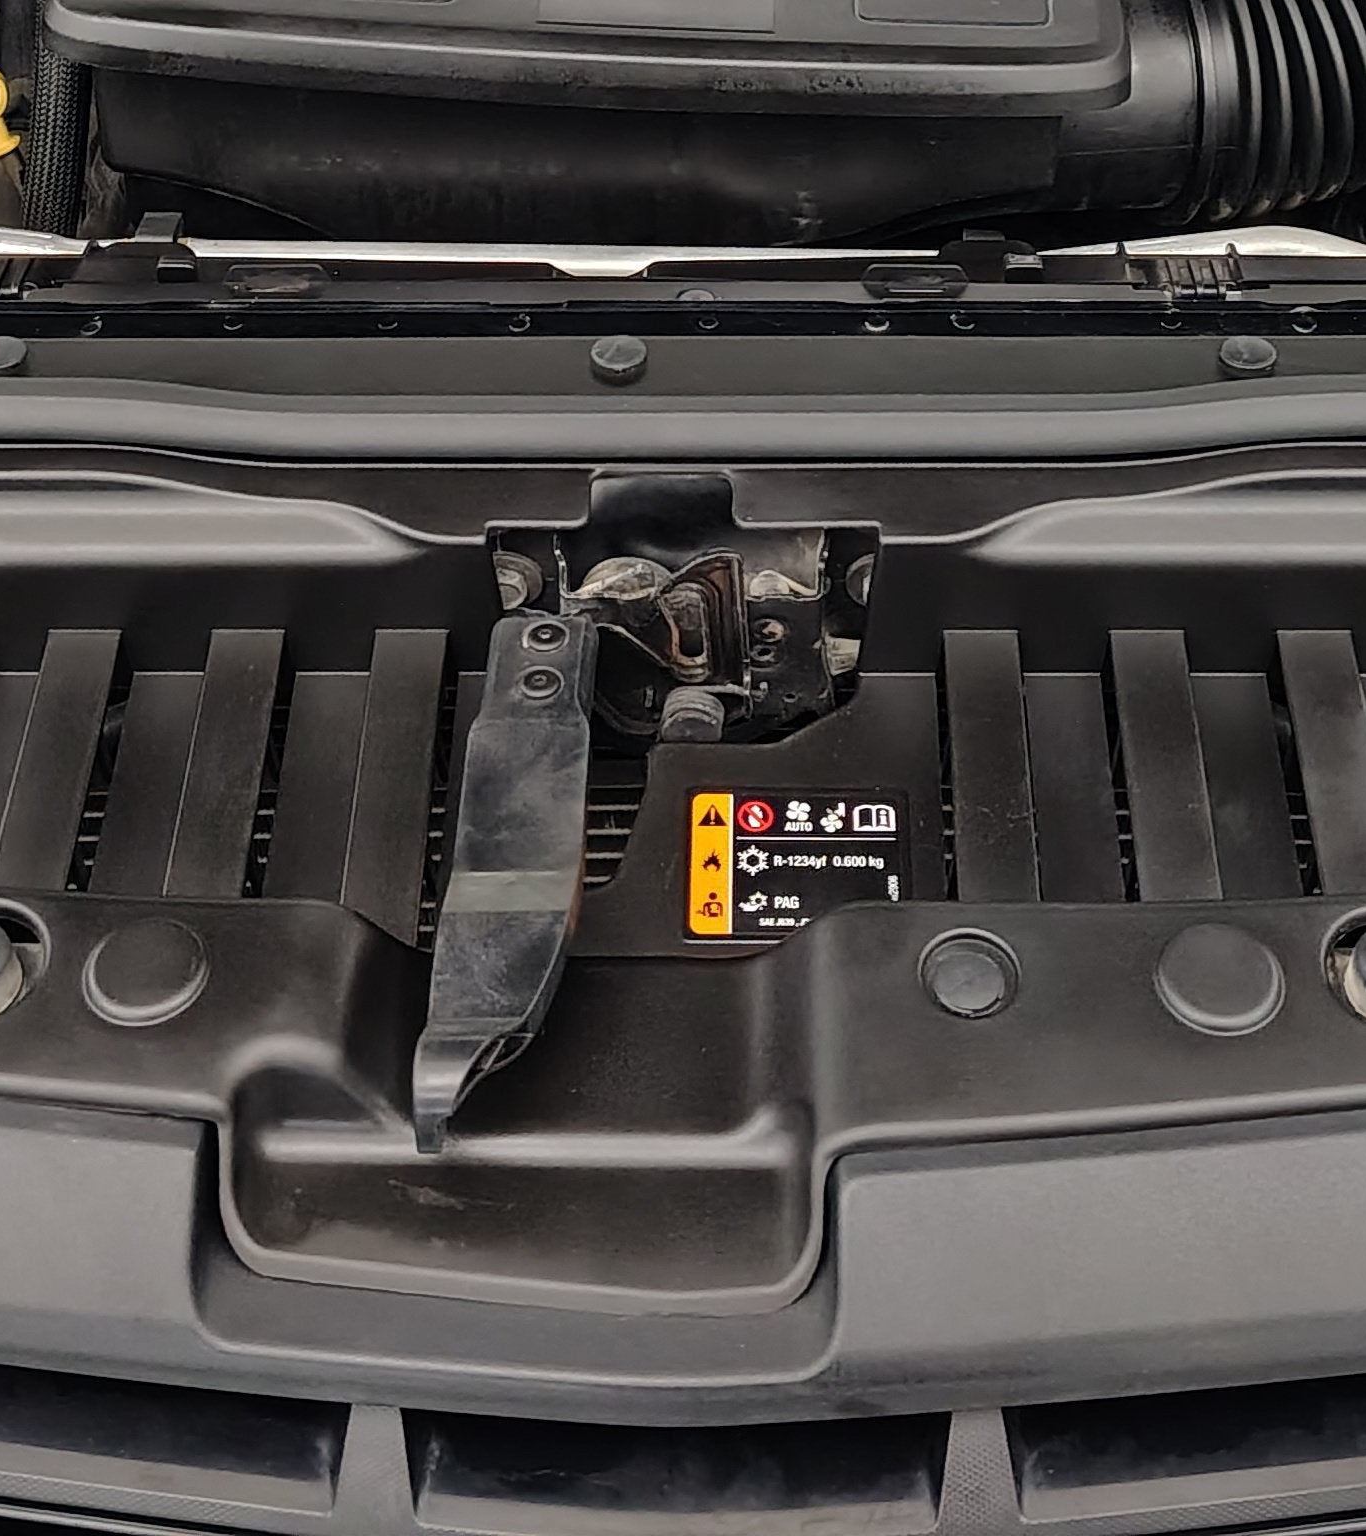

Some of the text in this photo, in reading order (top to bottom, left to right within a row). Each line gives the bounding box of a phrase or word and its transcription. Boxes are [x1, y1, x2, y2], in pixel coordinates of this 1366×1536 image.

[784, 821, 813, 832] AUTO
[773, 855, 827, 869] R-1234yf
[868, 855, 885, 869] kg
[774, 895, 800, 909] PAG
[759, 917, 775, 927] SAE
